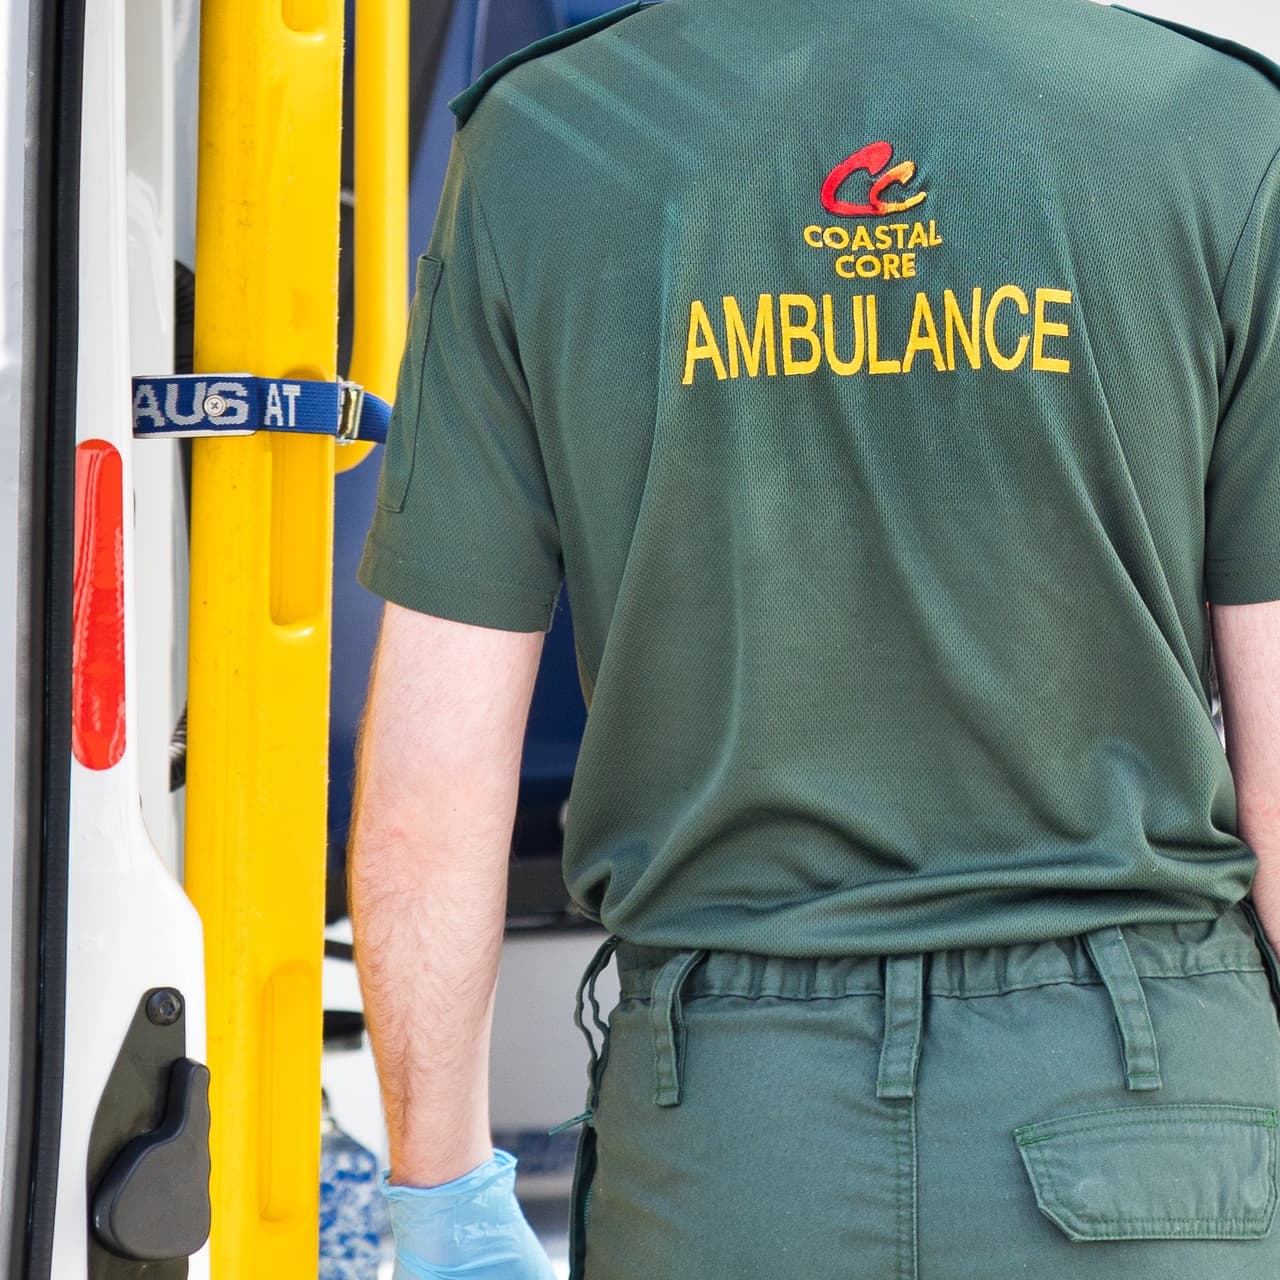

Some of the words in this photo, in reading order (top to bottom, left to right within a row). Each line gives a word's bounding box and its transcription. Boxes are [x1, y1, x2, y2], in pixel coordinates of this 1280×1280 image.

[803, 219, 943, 251] COASTAL
[835, 253, 917, 279] CORE
[681, 283, 1073, 384] AMBULANCE
[264, 382, 301, 427] AT
